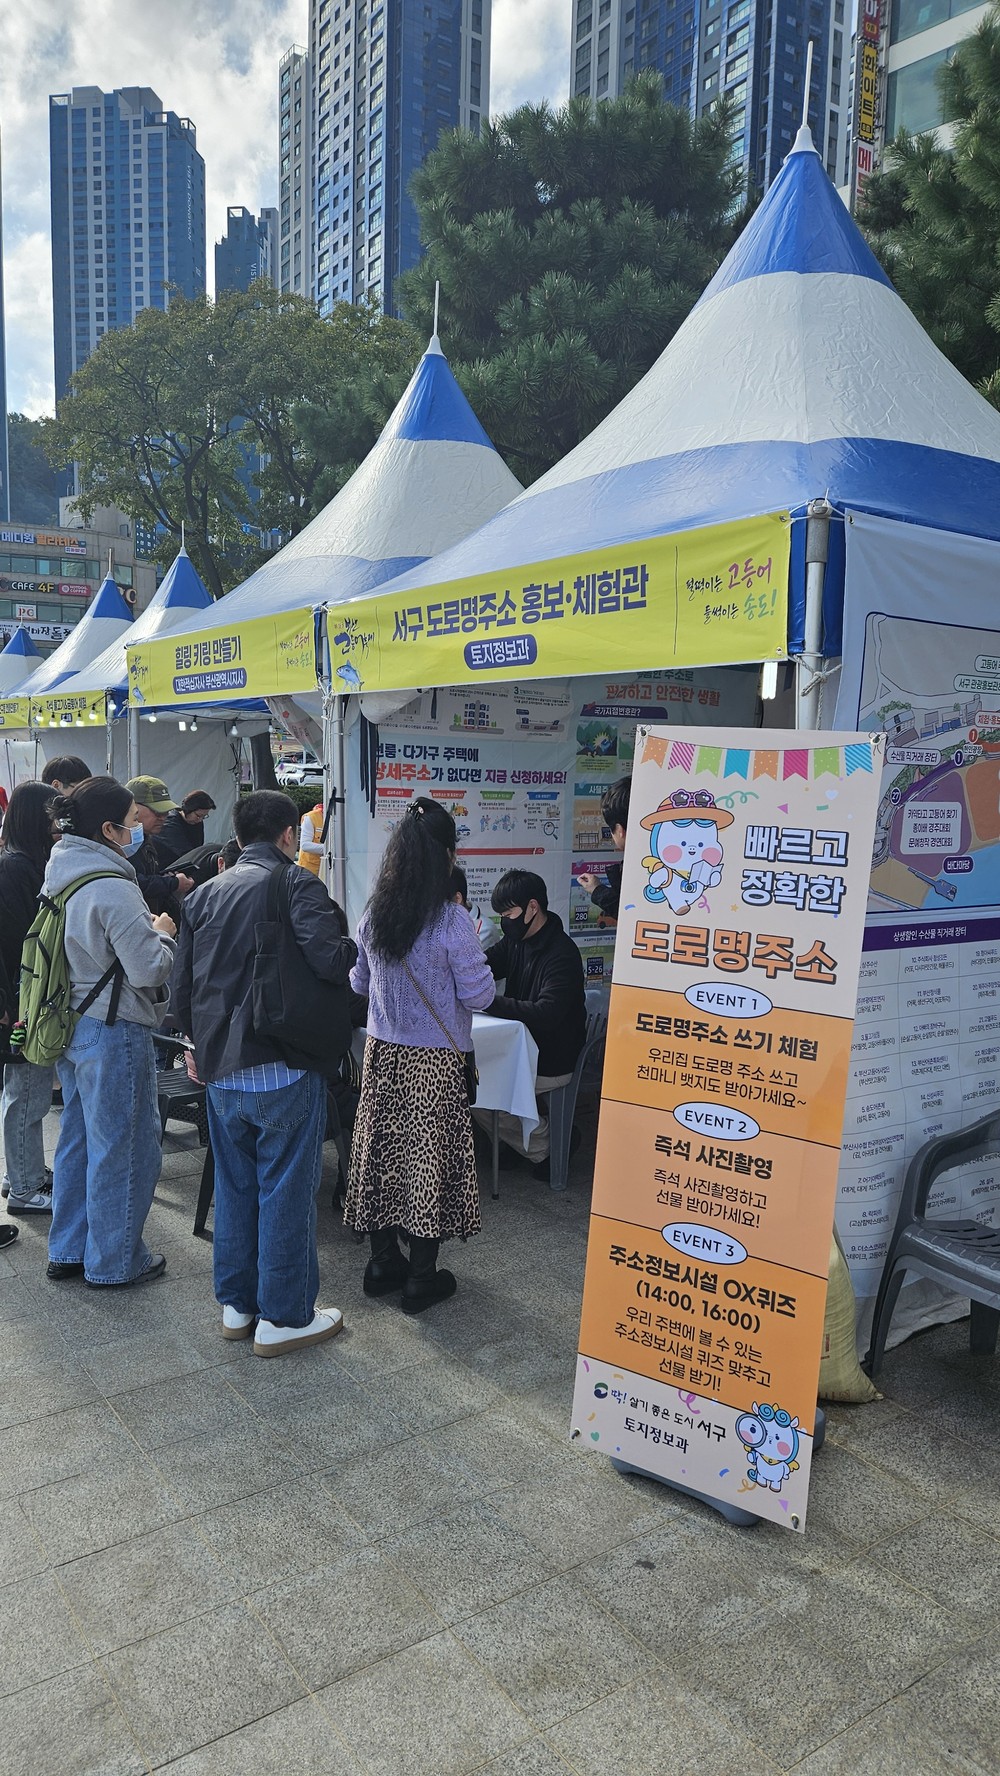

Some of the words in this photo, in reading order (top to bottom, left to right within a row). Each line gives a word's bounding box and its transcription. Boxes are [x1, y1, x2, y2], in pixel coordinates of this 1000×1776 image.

[862, 54, 875, 117] 화이트
[1, 531, 35, 544] 메디원
[11, 581, 35, 591] CAFE
[37, 582, 55, 593] 4F
[727, 557, 773, 589] 고등어
[392, 606, 425, 642] 서구
[426, 588, 517, 638] 도로명주소
[522, 563, 650, 624] 홍보·체험관
[743, 589, 778, 621] 송도!
[175, 644, 192, 670] 힐링
[193, 639, 211, 666] 키링
[212, 635, 242, 665] 만들기
[470, 638, 532, 668] 토지정보과
[175, 675, 205, 692] 대한적십자사
[205, 670, 244, 688] 부산광역시지사
[514, 686, 520, 695] 3
[606, 683, 652, 700] 편리하고
[656, 685, 695, 704] 안전한
[697, 689, 721, 707] 생활
[959, 678, 971, 689] 서구
[594, 707, 641, 717] 국가지점번호란?
[442, 746, 479, 763] 주택에
[891, 751, 905, 760] 수산물
[906, 751, 925, 762] 직거래
[925, 752, 938, 763] 장터
[447, 766, 482, 783] 없다면
[484, 769, 508, 784] 지금
[510, 771, 568, 785] 신청하세요!
[928, 809, 946, 819] 고등어
[946, 809, 958, 819] 찾기
[743, 824, 849, 867] 빠르고
[740, 869, 847, 914] 정확한
[575, 912, 588, 921] 280
[893, 930, 918, 942] 상생할인
[918, 929, 936, 940] 수산물
[937, 927, 955, 938] 직거래
[955, 926, 967, 936] 장터
[631, 919, 838, 985] 도로명주소
[696, 990, 746, 1009] EVENT
[752, 998, 758, 1010] 1
[635, 1012, 728, 1045] 도로명주소
[733, 1028, 773, 1053] 쓰기
[777, 1035, 819, 1062] 체험
[648, 1048, 689, 1068] 우리집
[691, 1055, 734, 1076] 도로명
[736, 1063, 765, 1082] 주소
[769, 1069, 799, 1088] 쓰고
[636, 1064, 677, 1085] 천마니
[680, 1073, 721, 1093] 뱃지도
[725, 1080, 807, 1109] 받아가세요~
[684, 1109, 735, 1130] EVENT
[738, 1121, 747, 1134] 2
[654, 1134, 690, 1161] 즉석
[695, 1144, 773, 1180] 사진촬영
[653, 1168, 682, 1190] 즉석
[683, 1176, 768, 1210] 사진촬영하고
[656, 1191, 683, 1209] 선물
[686, 1197, 760, 1229] 받아가세요!
[673, 1230, 723, 1254] EVENT
[725, 1244, 735, 1257] 3
[609, 1244, 718, 1295] 주소정보시설
[722, 1279, 797, 1319] OX퀴즈
[636, 1279, 696, 1315] (14:00,
[701, 1299, 761, 1334] 16:00)
[625, 1306, 652, 1328] 우리
[654, 1315, 695, 1341] 주변에
[699, 1329, 713, 1346] 볼
[716, 1334, 730, 1353] 수
[734, 1340, 763, 1364] 있는
[614, 1322, 693, 1360] 주소정보시설
[696, 1349, 724, 1372] 퀴즈
[728, 1360, 772, 1388] 맞추고
[659, 1357, 686, 1380] 선물
[689, 1368, 722, 1392] 받기!
[623, 1416, 689, 1454] 토지정보과
[629, 1396, 649, 1412] 살기
[651, 1403, 671, 1421] 좋은
[673, 1412, 695, 1429] 도시
[696, 1419, 727, 1443] 서구
